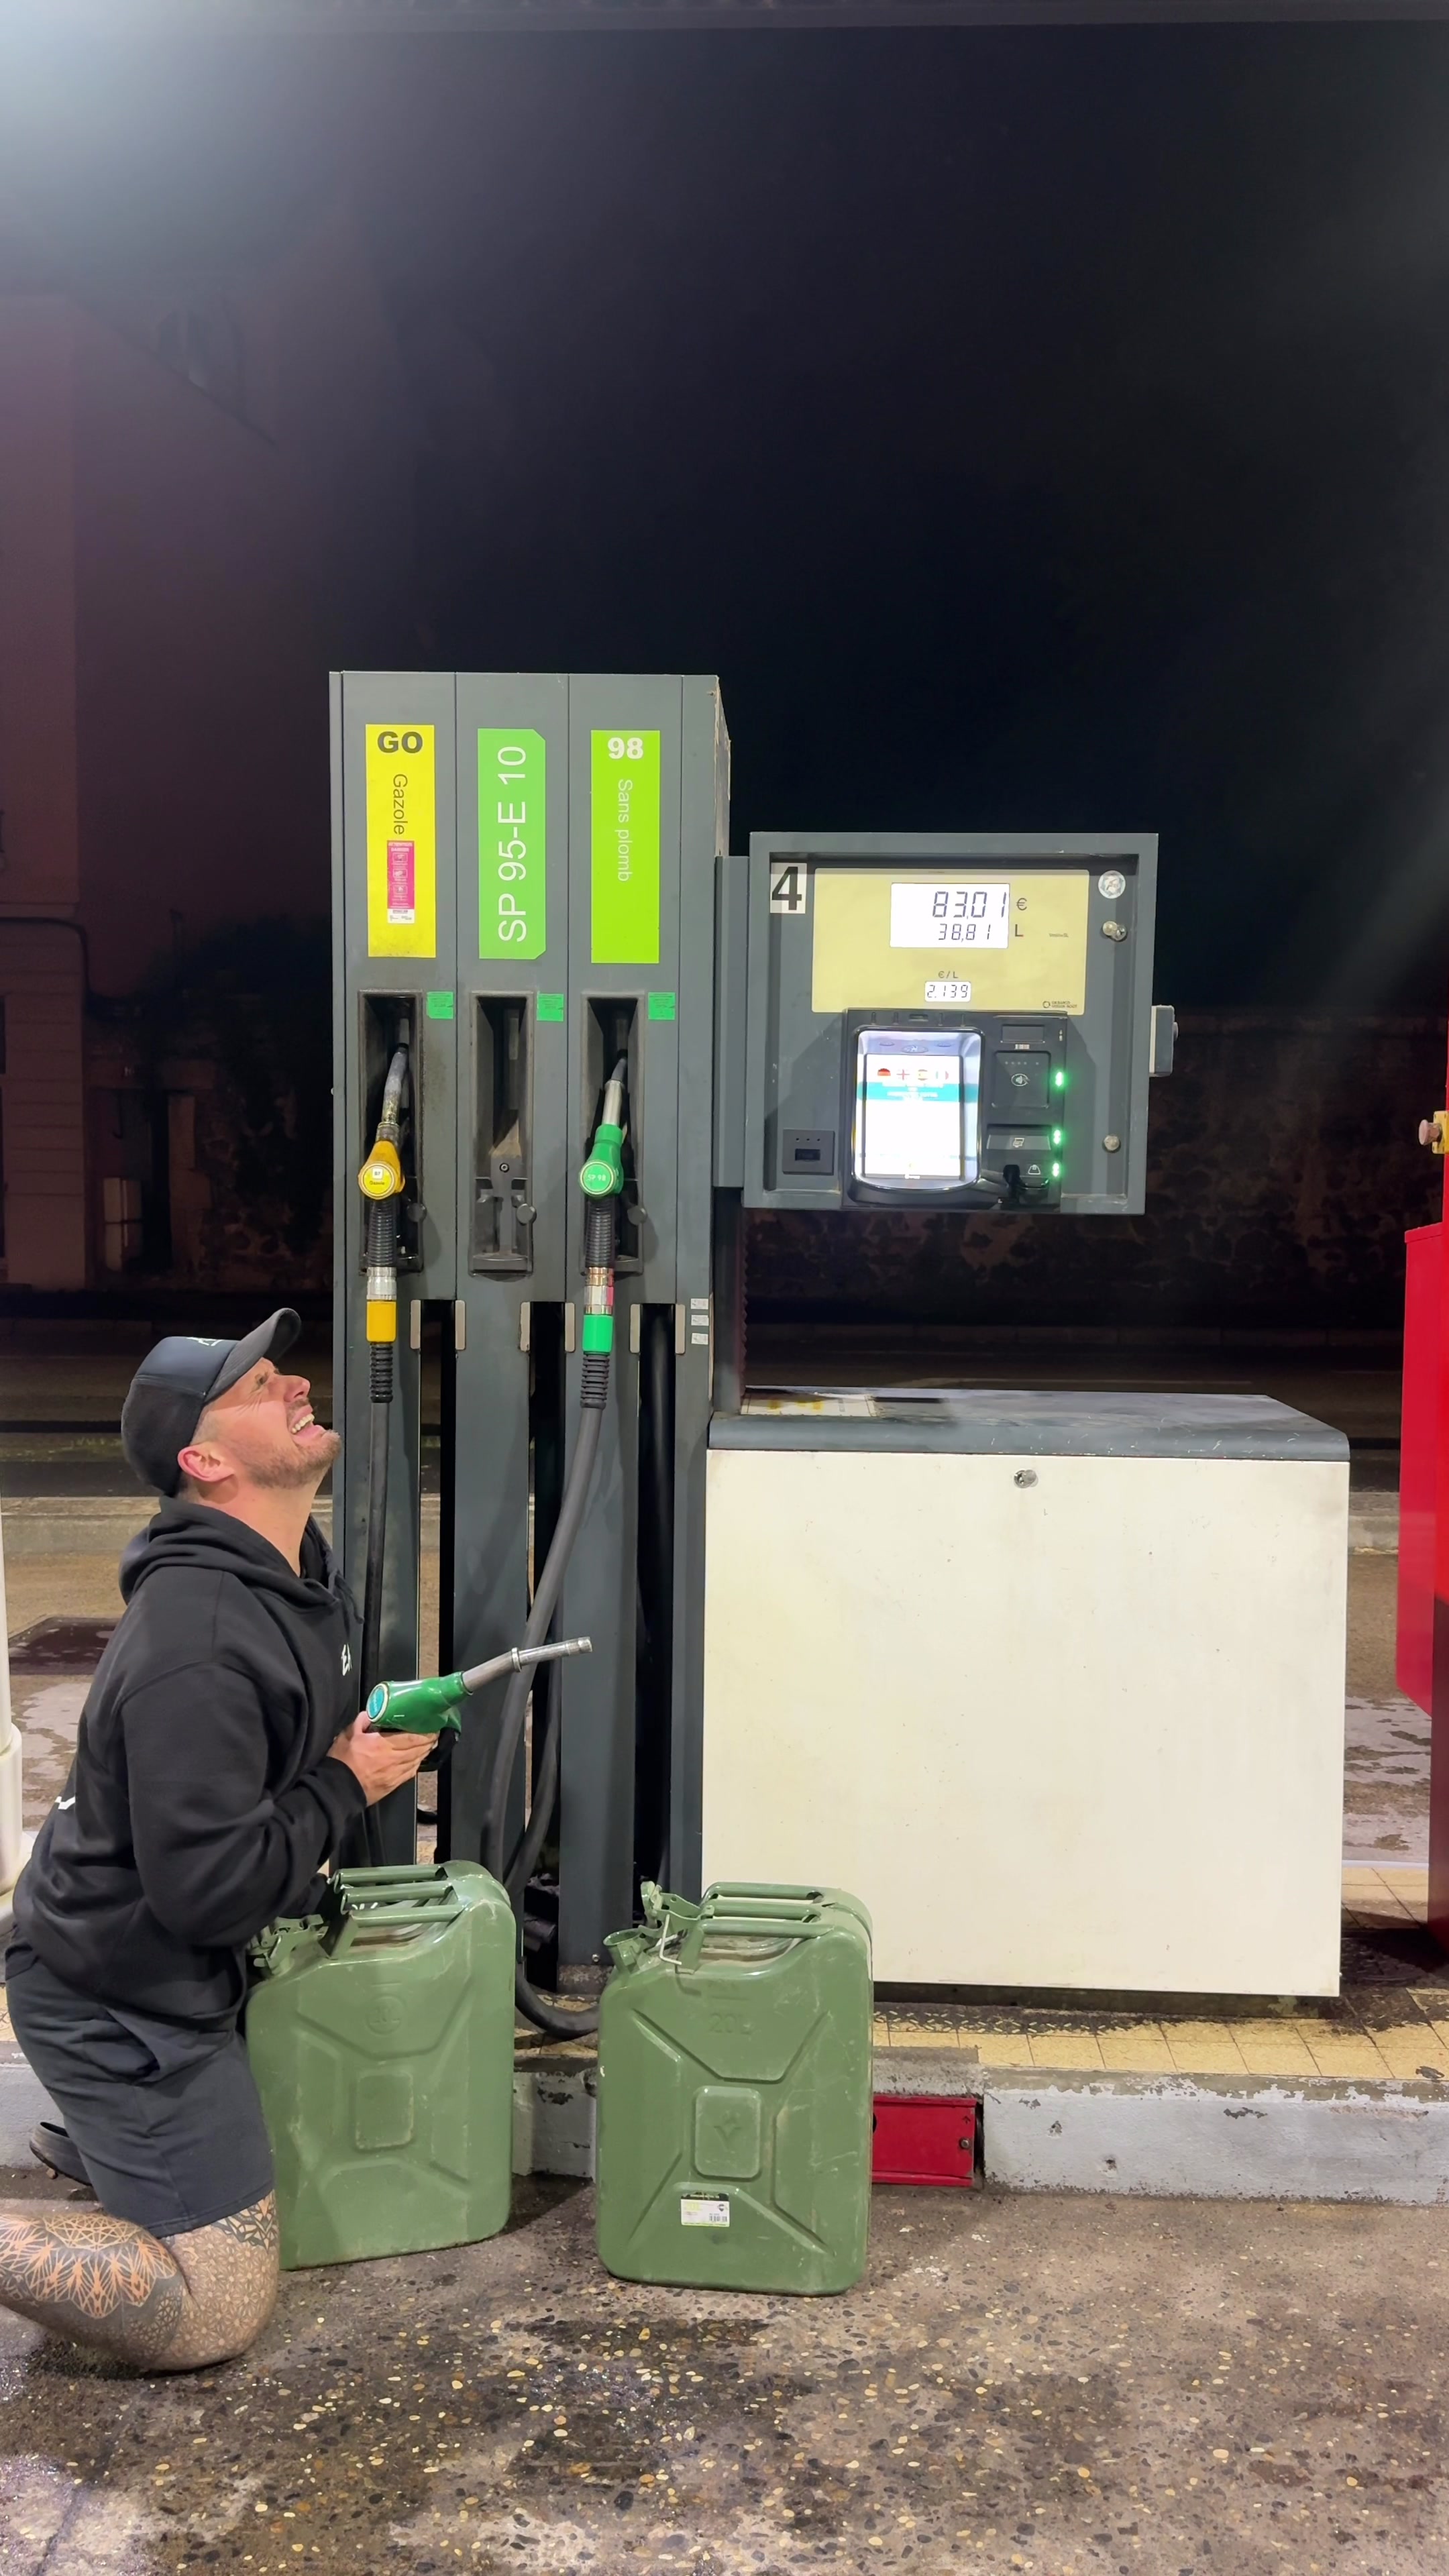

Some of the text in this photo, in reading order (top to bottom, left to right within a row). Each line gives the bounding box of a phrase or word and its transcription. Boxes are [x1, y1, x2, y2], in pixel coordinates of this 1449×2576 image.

[377, 731, 423, 753] GO
[608, 737, 643, 759] 98
[392, 773, 408, 835] Gazole
[497, 746, 527, 942] SP 95-E 10
[614, 779, 633, 882] Sans plomb
[771, 866, 802, 911] 4
[1015, 924, 1024, 937] L
